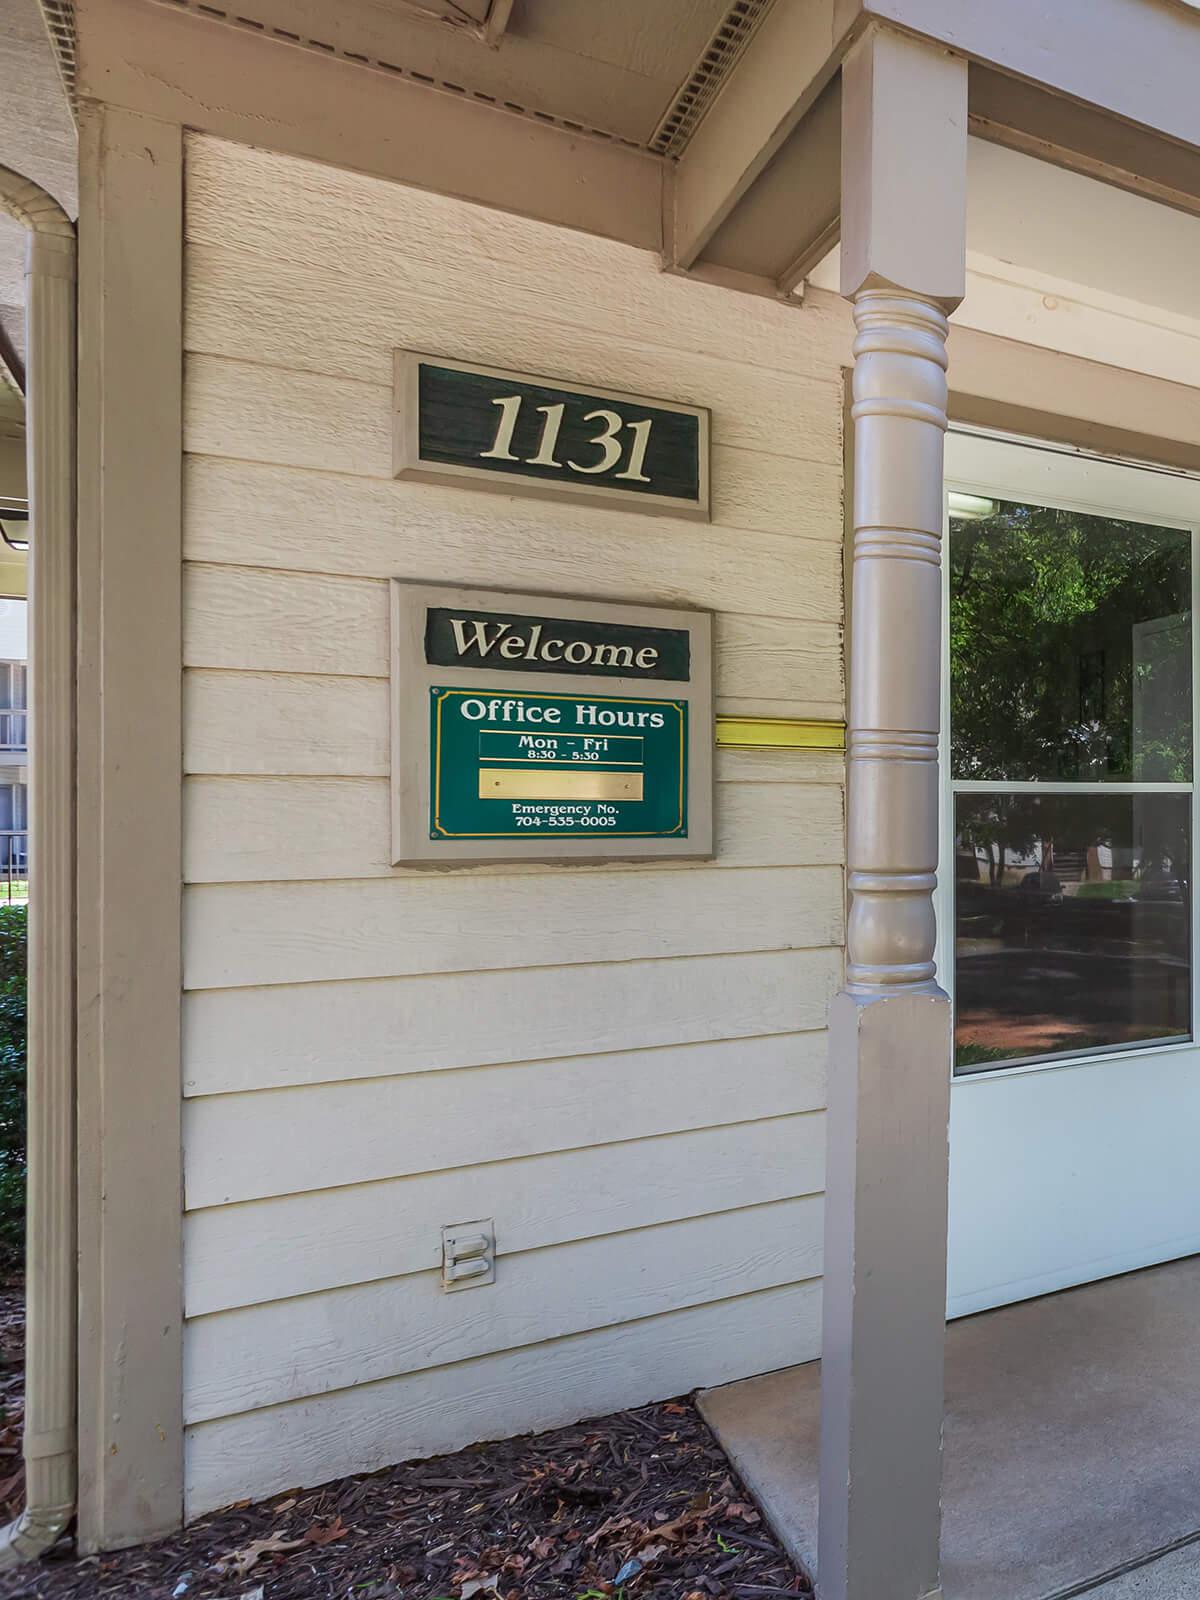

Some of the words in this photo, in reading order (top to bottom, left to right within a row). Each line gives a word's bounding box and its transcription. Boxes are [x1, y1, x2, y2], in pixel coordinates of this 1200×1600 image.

[480, 396, 652, 482] 1131
[450, 619, 658, 668] Welcome
[460, 699, 561, 724] Office
[575, 705, 665, 728] Hours
[518, 735, 558, 749] Mon
[583, 738, 609, 751] Fri
[527, 750, 556, 759] 8:30
[572, 751, 600, 760] 5:30
[511, 803, 591, 816] Emergency
[597, 804, 620, 814] No.
[515, 816, 617, 826] 704-535-0005
